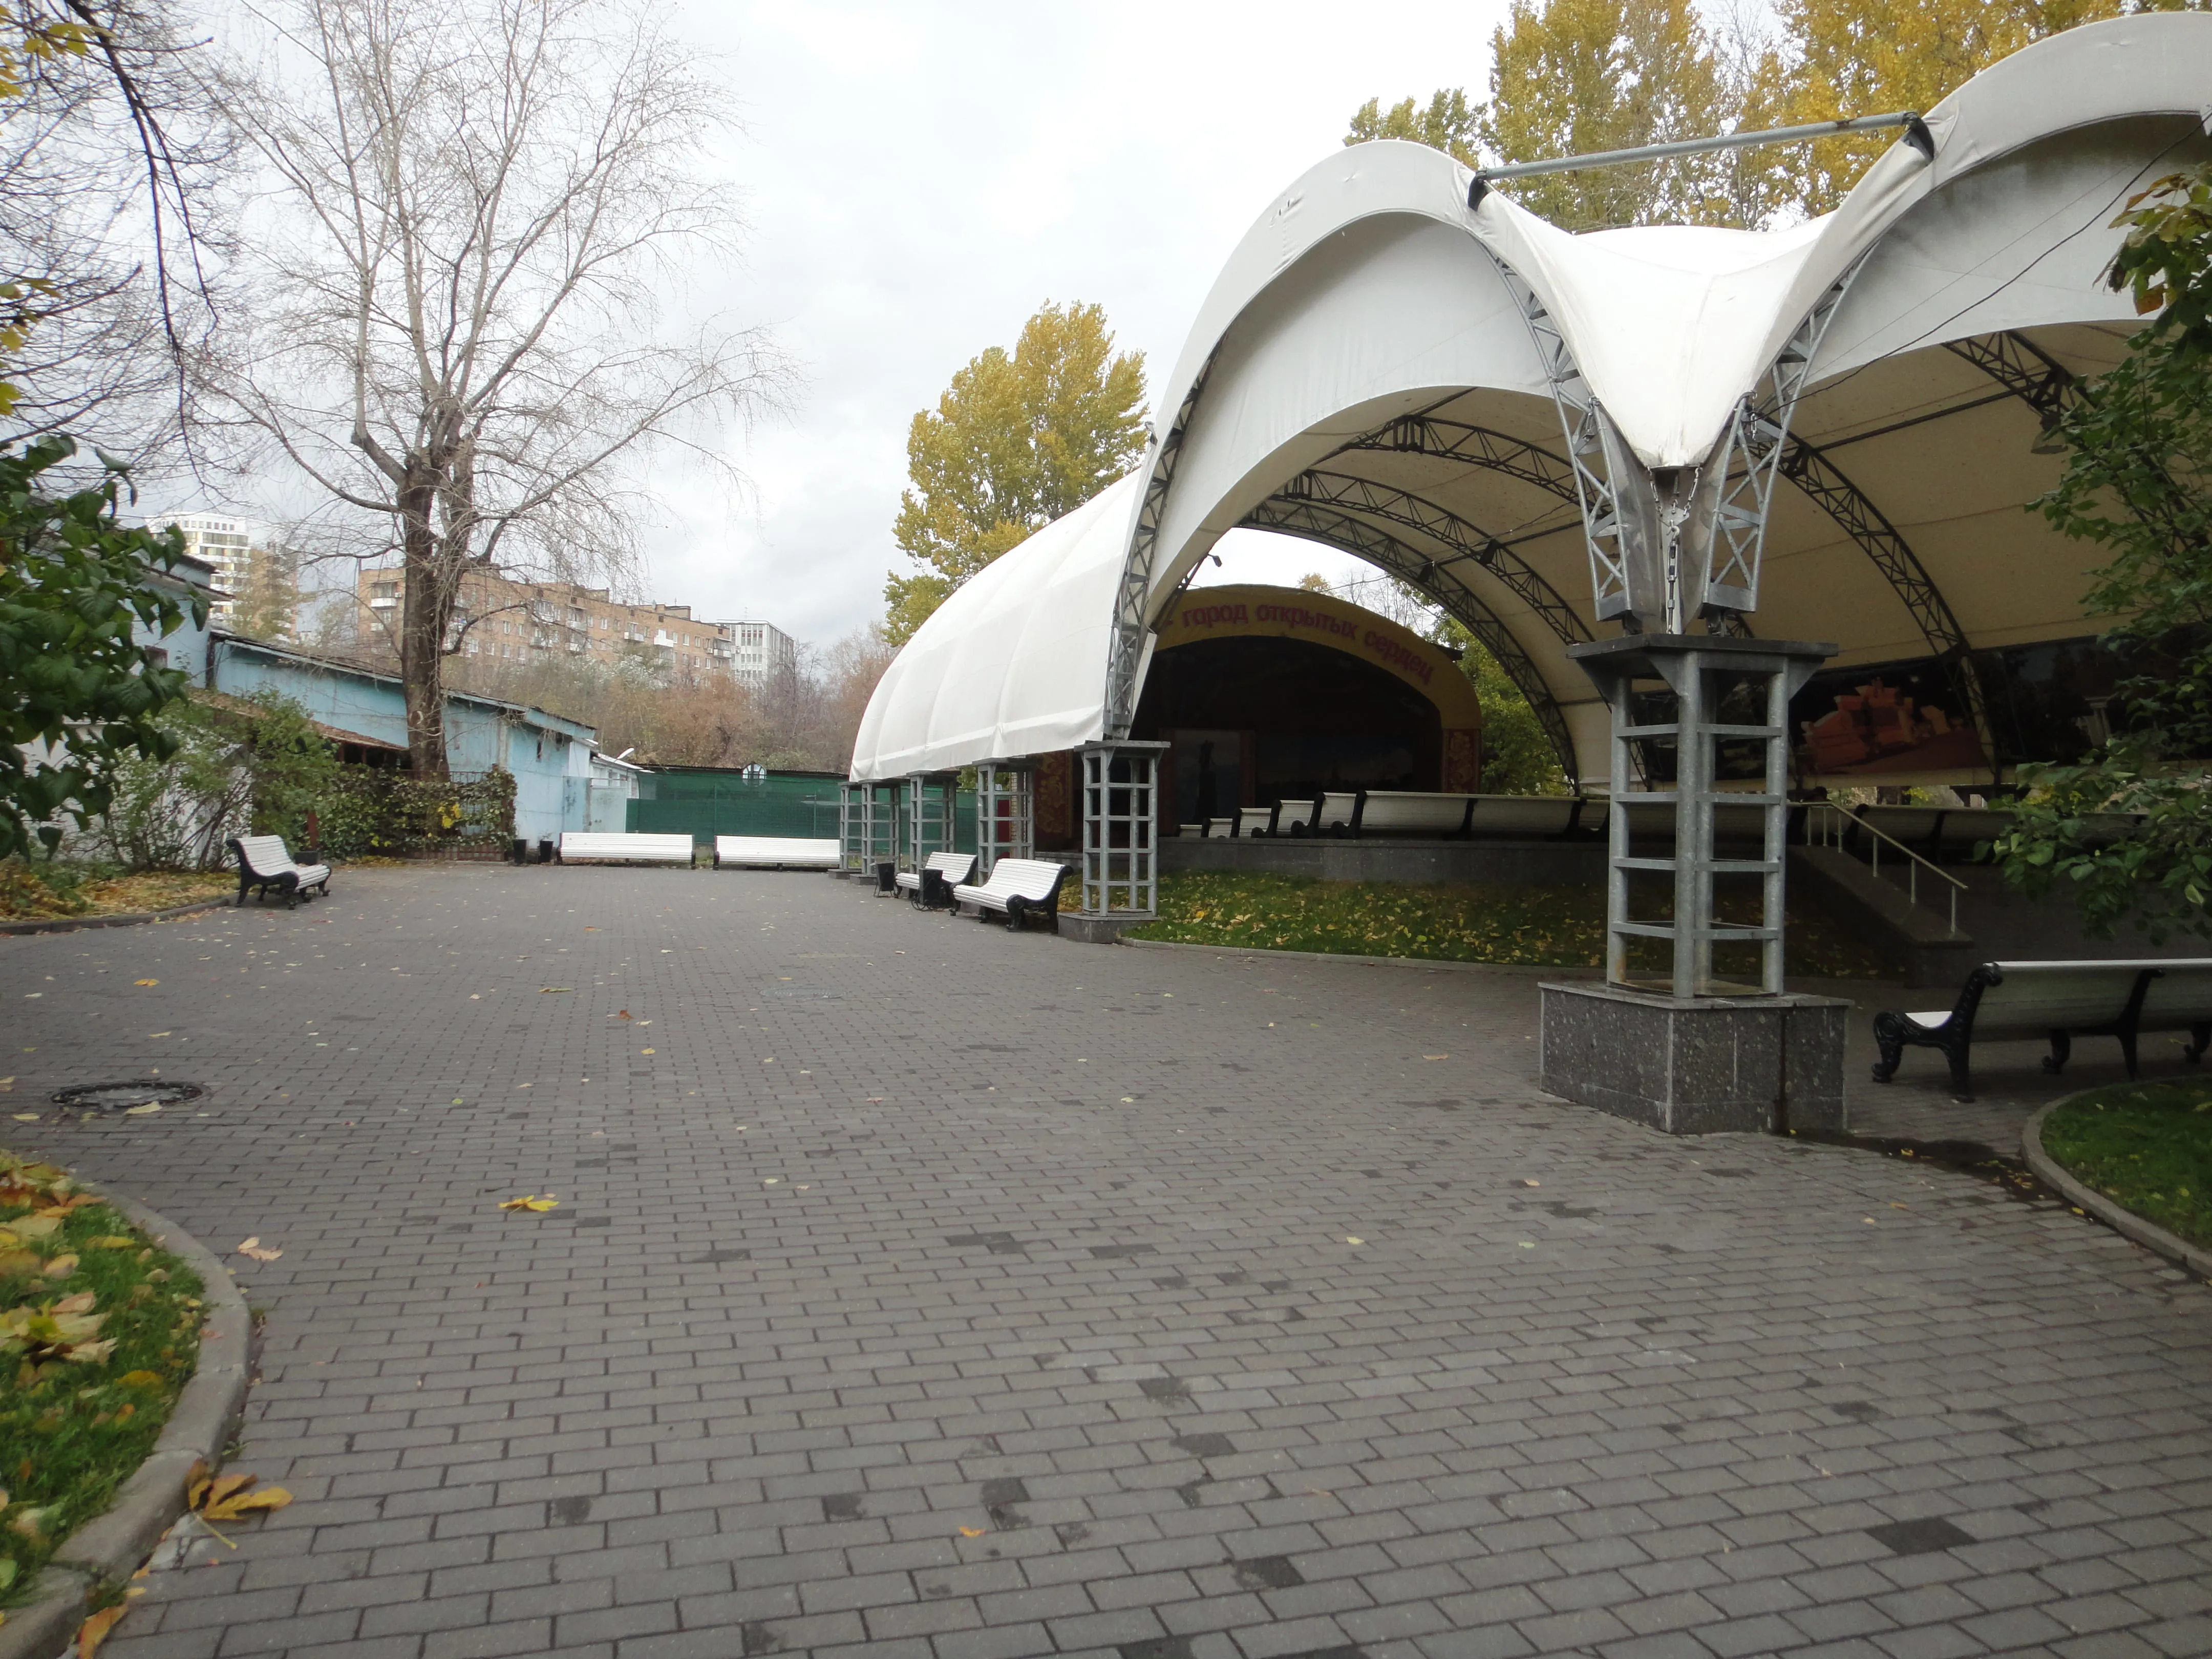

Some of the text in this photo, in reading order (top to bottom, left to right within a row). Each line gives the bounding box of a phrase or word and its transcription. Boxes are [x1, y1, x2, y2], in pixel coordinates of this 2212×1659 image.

[1182, 604, 1434, 685] город открытых сердец
